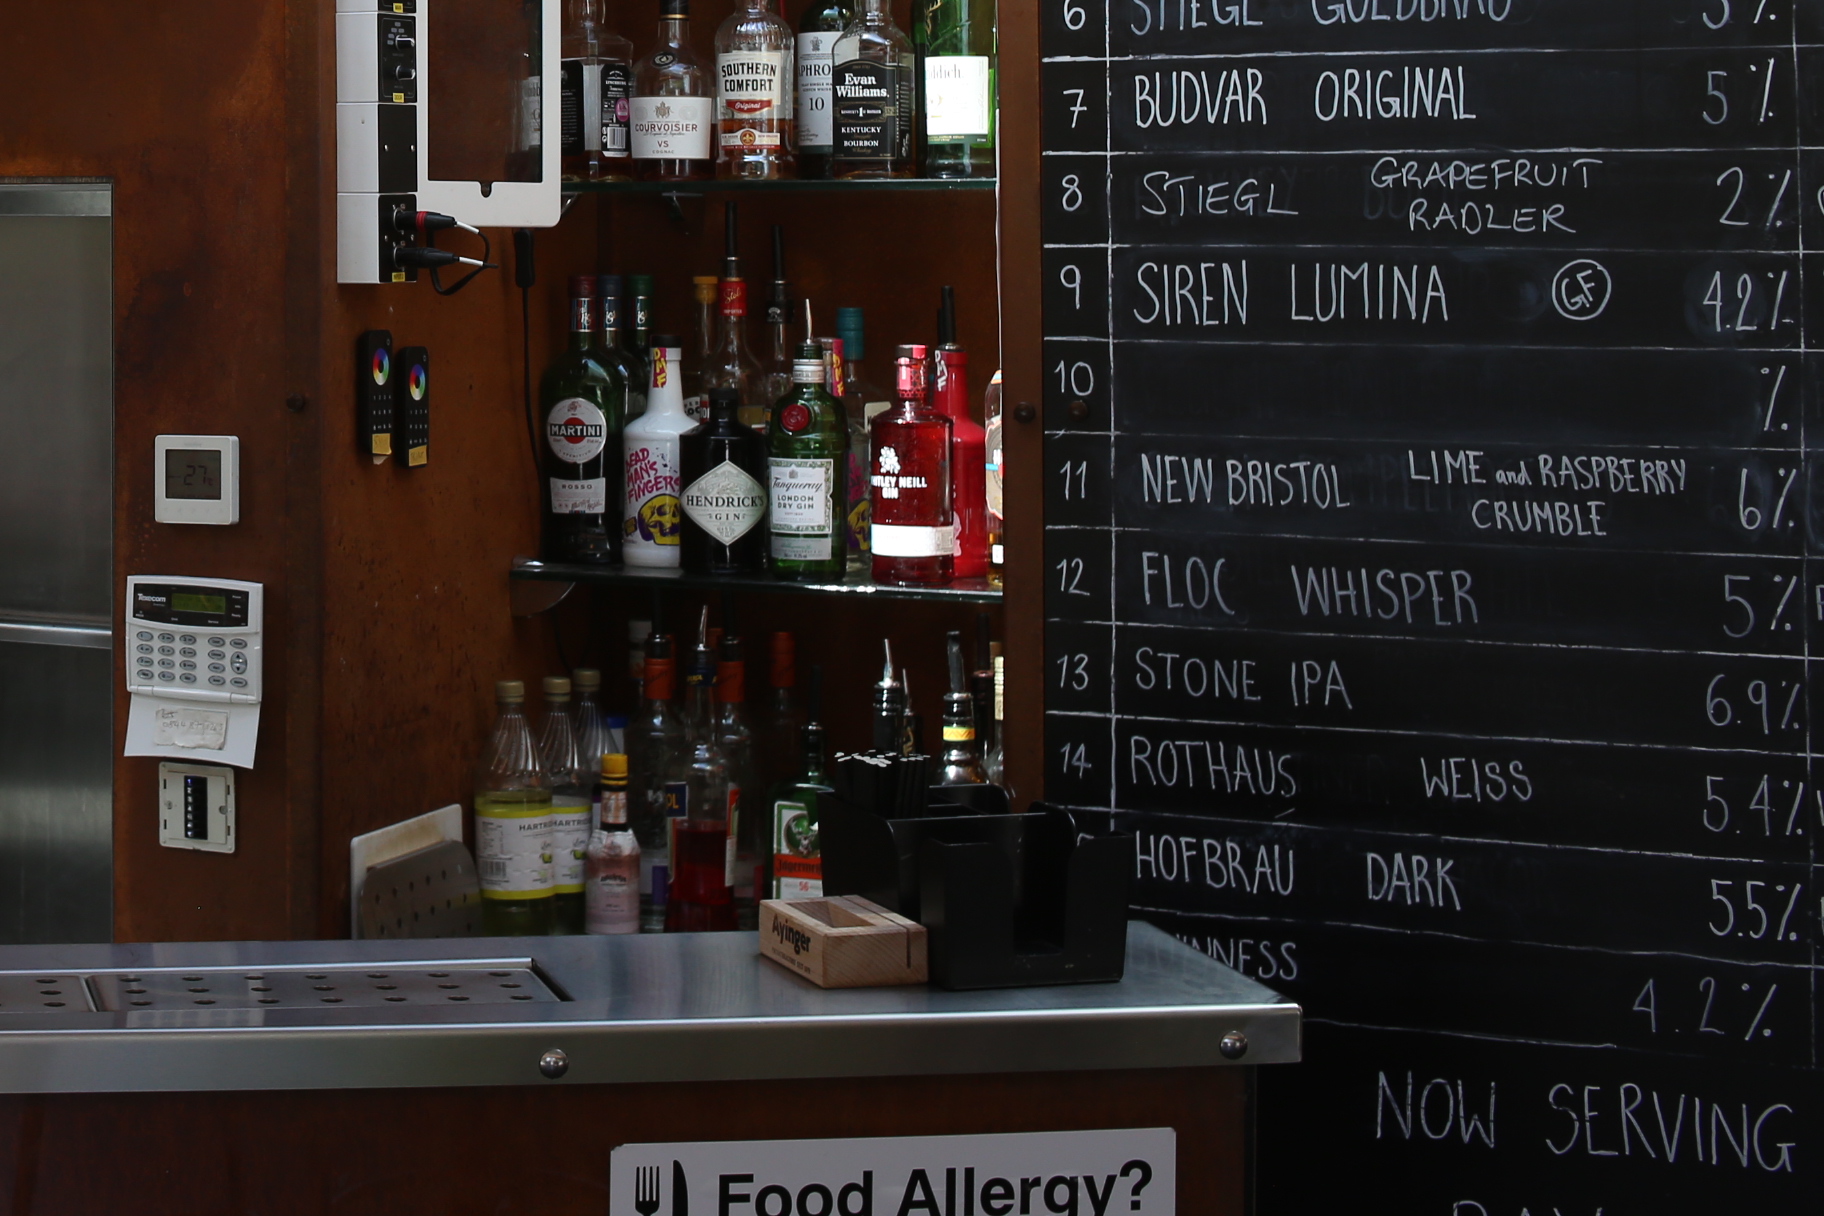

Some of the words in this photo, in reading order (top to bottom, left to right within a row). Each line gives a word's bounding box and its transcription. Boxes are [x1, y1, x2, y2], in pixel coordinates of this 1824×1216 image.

[722, 63, 777, 77] SOUTHERN
[725, 79, 773, 92] COMFORT
[844, 73, 876, 85] Evan
[735, 102, 761, 110] Original
[809, 97, 824, 111] 10
[1064, 89, 1087, 128] 7
[1134, 68, 1268, 129] BUDVAR
[1314, 65, 1477, 123] ORIGINAL
[635, 124, 697, 132] COURVOISIER
[844, 139, 878, 147] BOURBON
[1370, 156, 1603, 191] GRAPEFRUIT
[1063, 175, 1082, 212] 8
[1140, 171, 1299, 216] STIEGL
[1408, 198, 1577, 234] RADLER
[1060, 265, 1082, 309] 9
[1133, 259, 1249, 326] SIREN
[1290, 263, 1449, 323] LUMINA
[1054, 360, 1094, 398] 10
[551, 425, 601, 436] MARTINI
[882, 488, 899, 499] GIN
[899, 477, 927, 488] NEILL
[1060, 461, 1087, 503] 11
[1142, 451, 1214, 506] NEW
[1226, 459, 1350, 510] BRISTOL
[1408, 449, 1484, 486] LIME
[1496, 460, 1532, 488] and
[1539, 452, 1686, 496] RASPBERRY
[686, 495, 765, 507] HENDRICK'S
[714, 513, 741, 521] GIN
[777, 502, 793, 510] DRY
[796, 502, 814, 510] GIN
[1471, 498, 1607, 537] CRUMBLE
[1056, 558, 1091, 597] 12
[1143, 550, 1236, 616] FLOC
[1292, 564, 1480, 628] WHISPER
[1057, 652, 1092, 688] 13
[1135, 645, 1262, 702] STONE
[1290, 657, 1353, 709] IPA
[1060, 742, 1092, 776] 14
[1130, 735, 1296, 798] ROTHAUS
[1421, 756, 1532, 802] WEISS
[1135, 831, 1294, 896] HOFBRAU
[1367, 852, 1462, 911] DARK
[772, 913, 811, 955] Ayinger
[1377, 1070, 1496, 1147] NOW
[1545, 1083, 1796, 1173] SERVING
[718, 1171, 873, 1216] Food
[898, 1159, 1154, 1216] Allergy?
